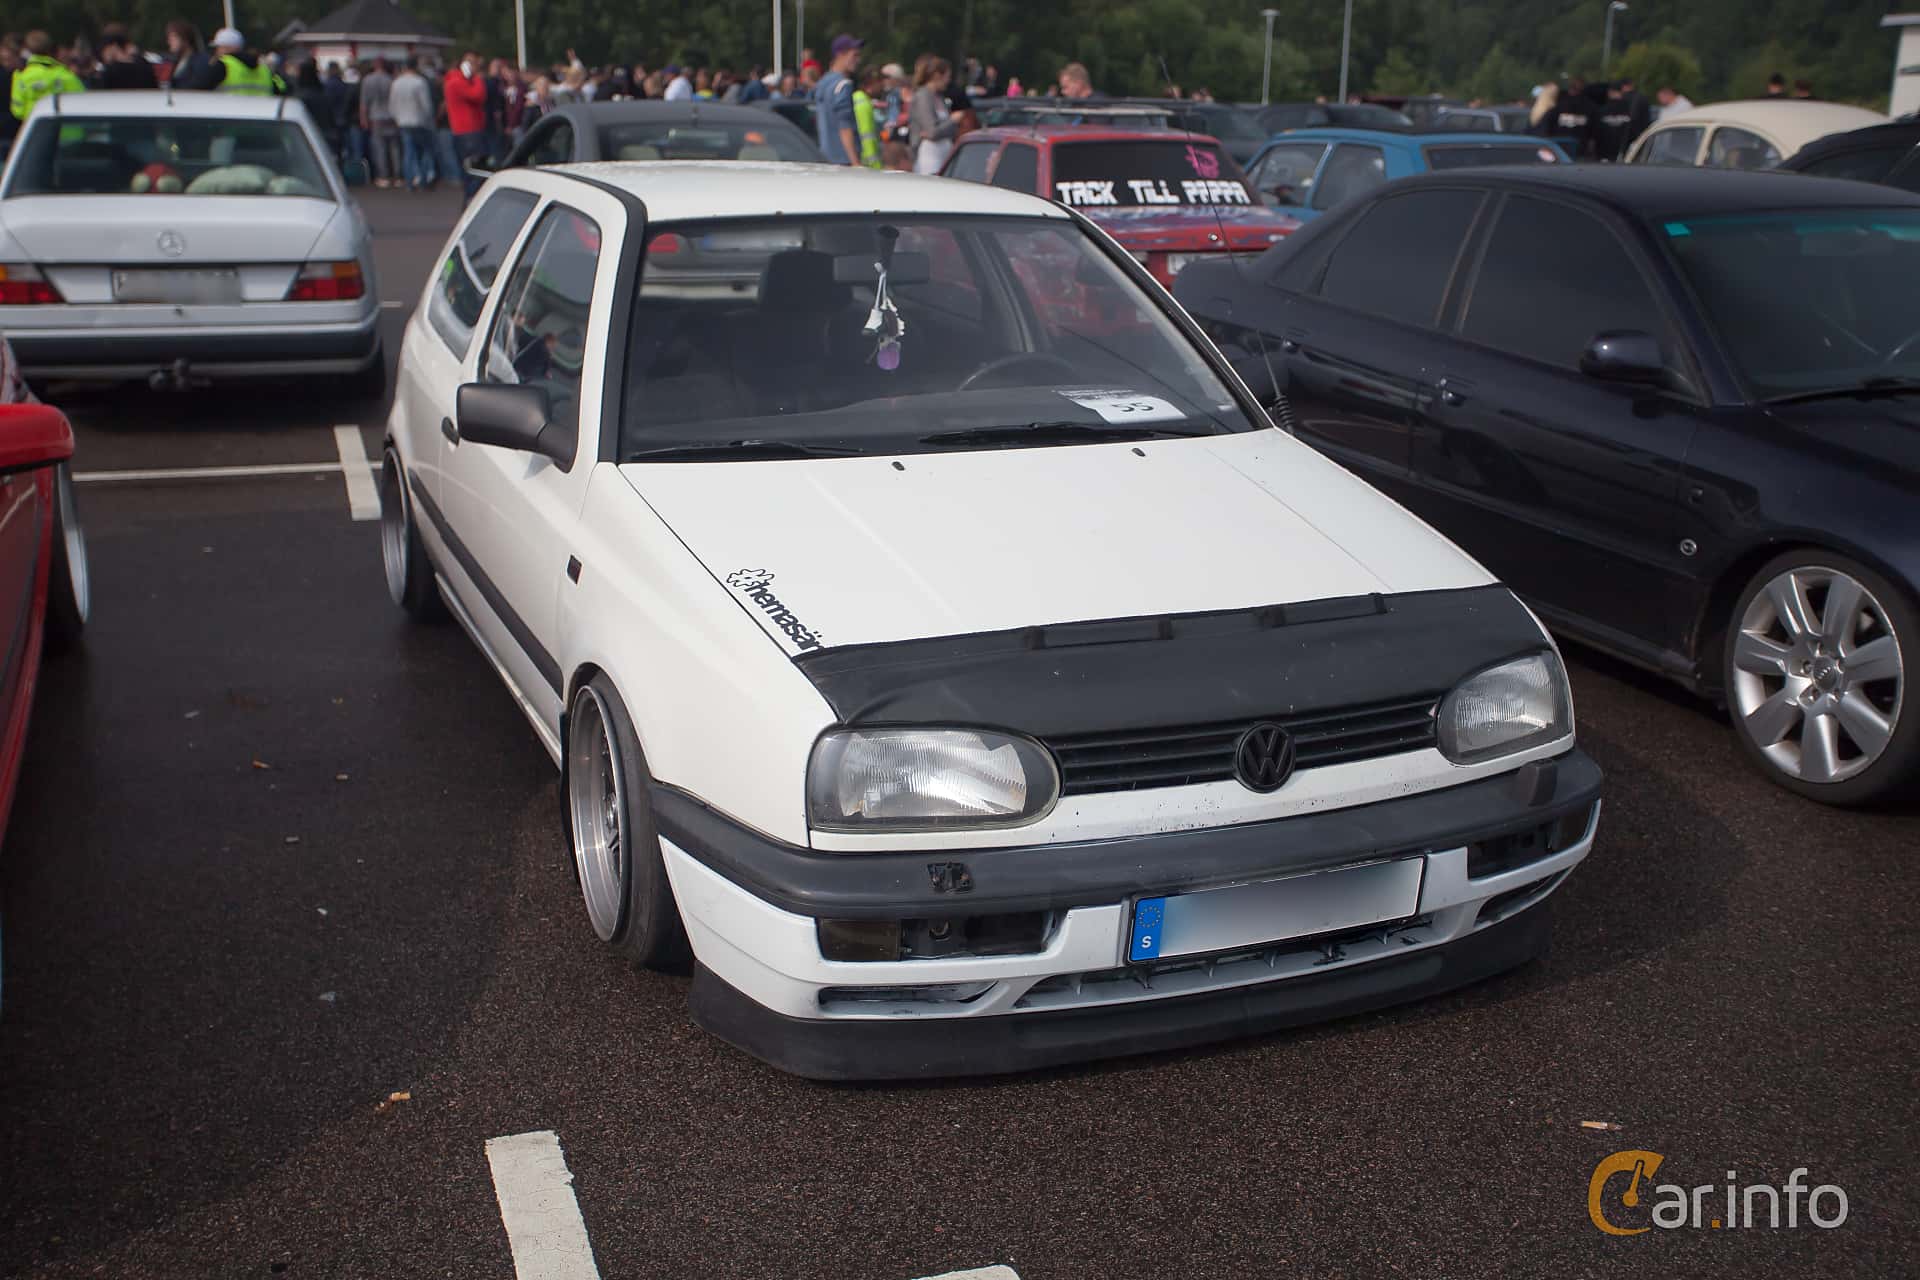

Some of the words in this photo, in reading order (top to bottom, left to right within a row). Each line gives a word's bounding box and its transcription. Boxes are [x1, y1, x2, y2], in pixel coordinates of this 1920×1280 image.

[1056, 181, 1118, 205] TACK
[1127, 180, 1181, 204] TILL
[1180, 180, 1250, 204] PAPPA
[1141, 935, 1152, 949] S
